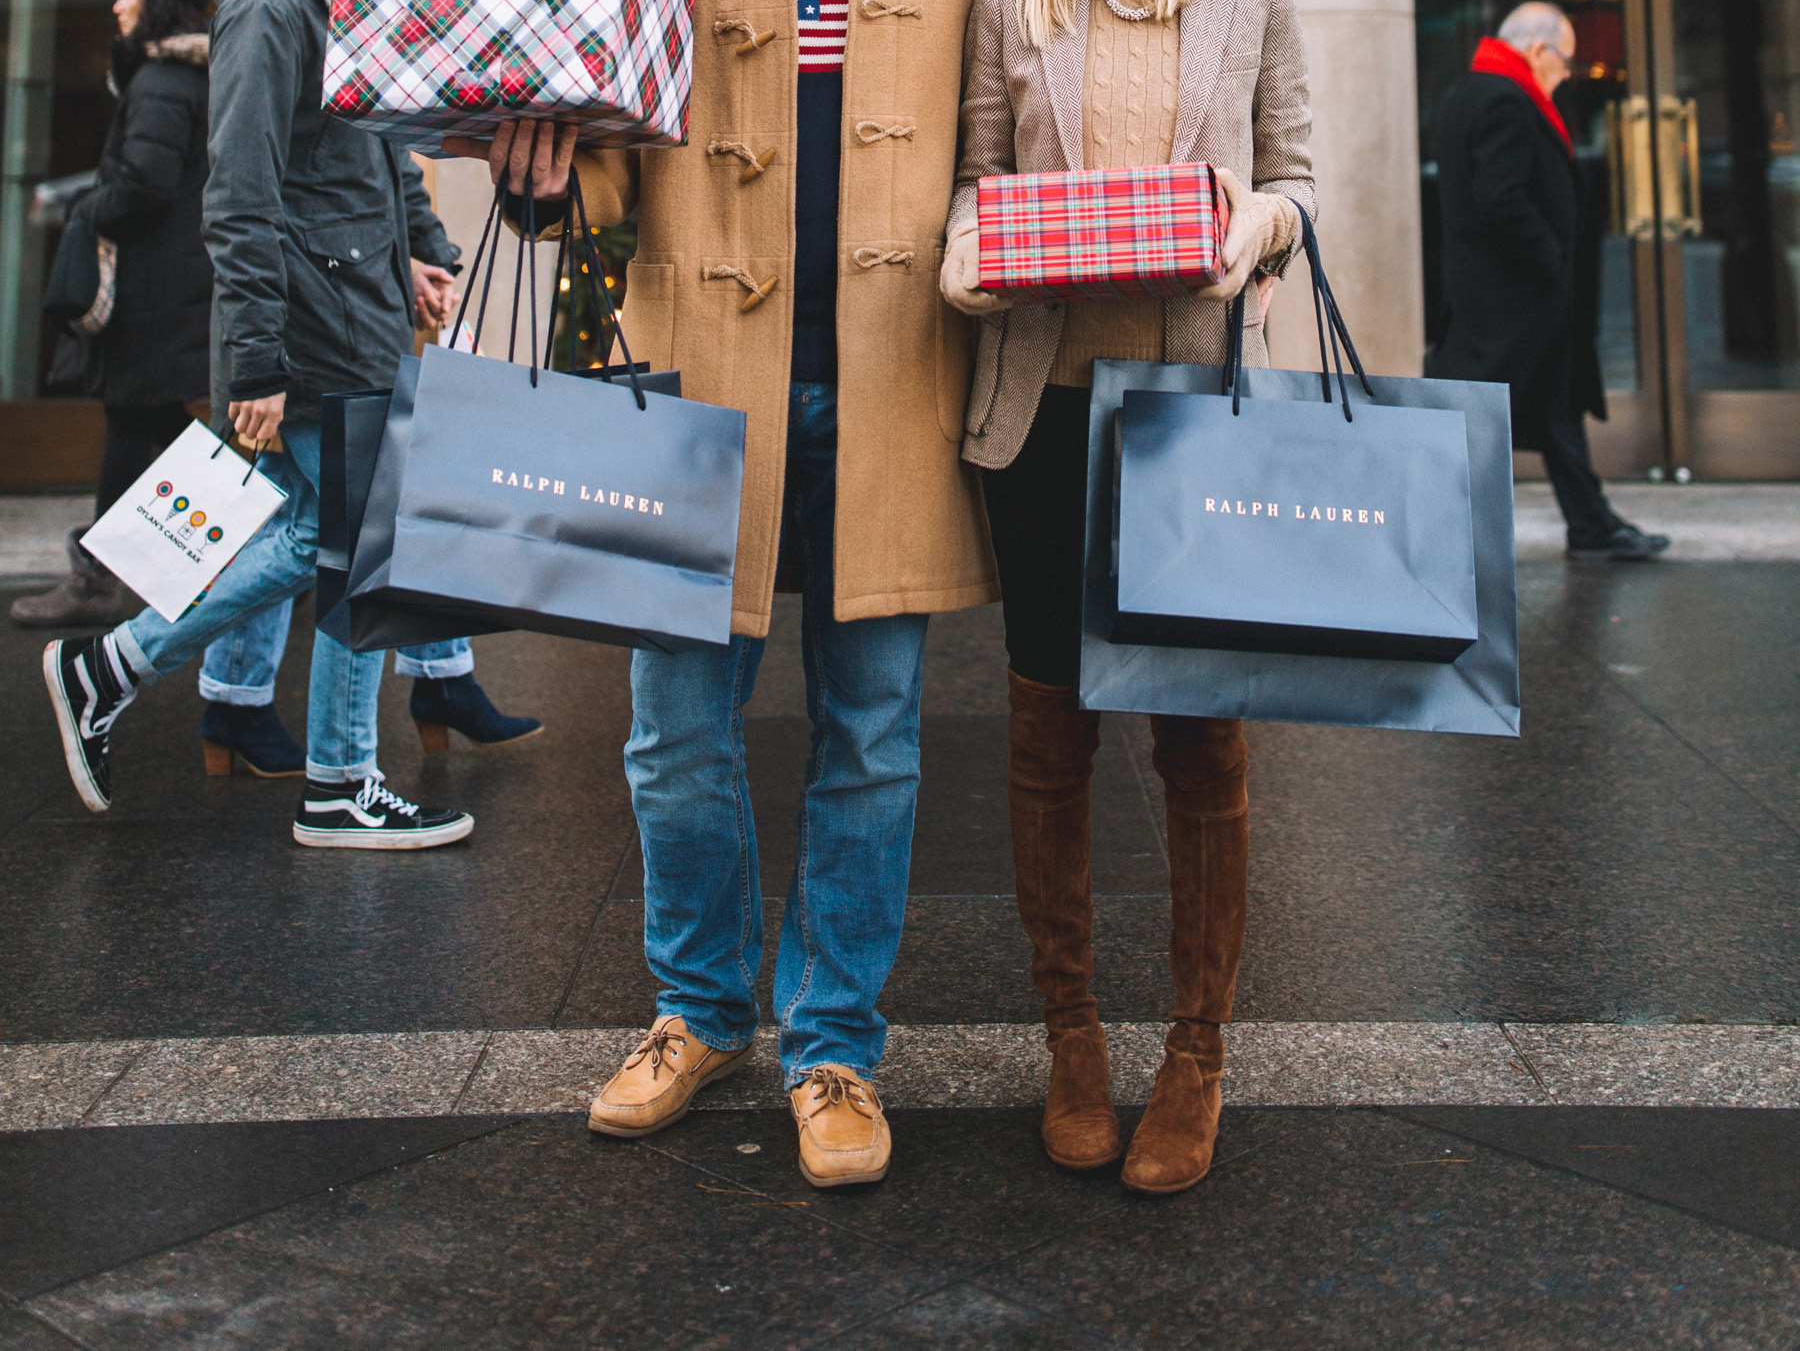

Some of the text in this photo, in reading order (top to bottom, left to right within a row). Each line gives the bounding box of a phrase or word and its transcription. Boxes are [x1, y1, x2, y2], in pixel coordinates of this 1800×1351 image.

[492, 468, 664, 516] RALPH LAUREN
[1204, 498, 1385, 524] RALPH LAUREN
[136, 505, 201, 564] DYLAN'S CANDY BAR
